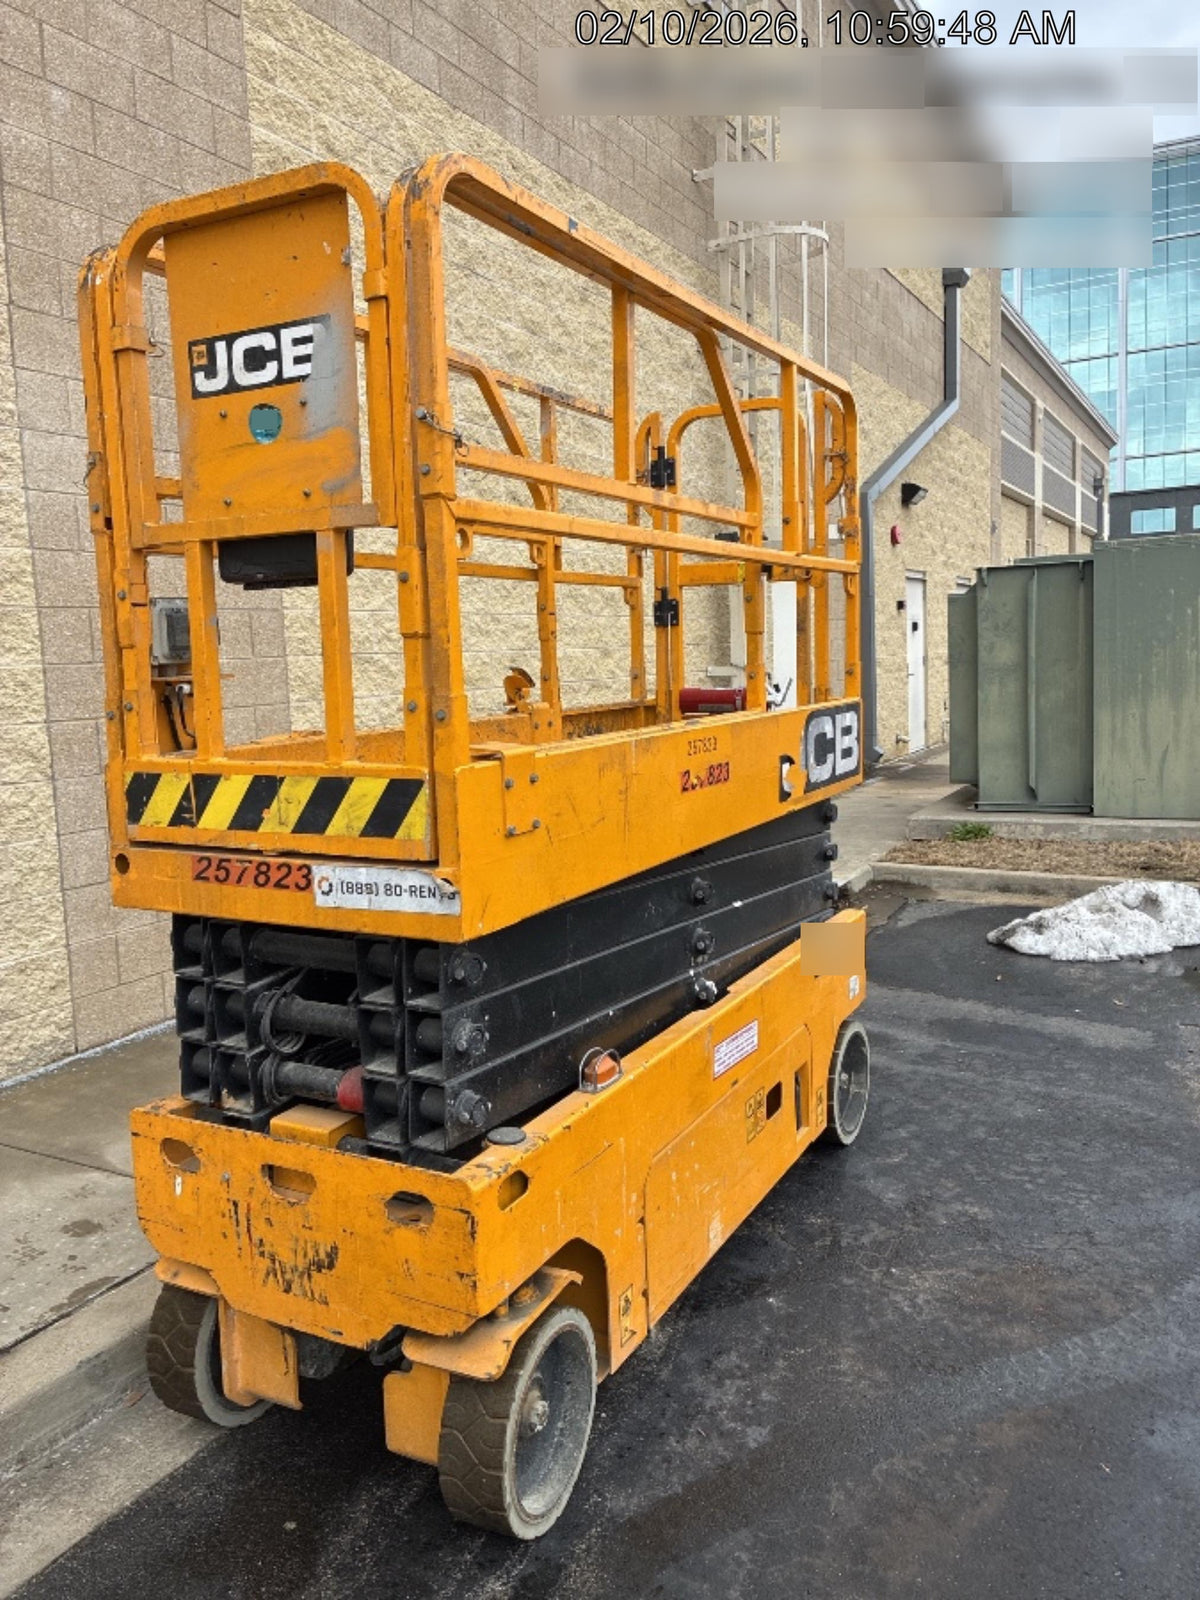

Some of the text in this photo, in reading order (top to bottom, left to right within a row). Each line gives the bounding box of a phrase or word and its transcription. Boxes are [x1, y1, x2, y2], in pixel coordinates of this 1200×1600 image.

[781, 710, 860, 793] CB
[193, 856, 312, 891] 257823
[340, 880, 380, 897] (888)
